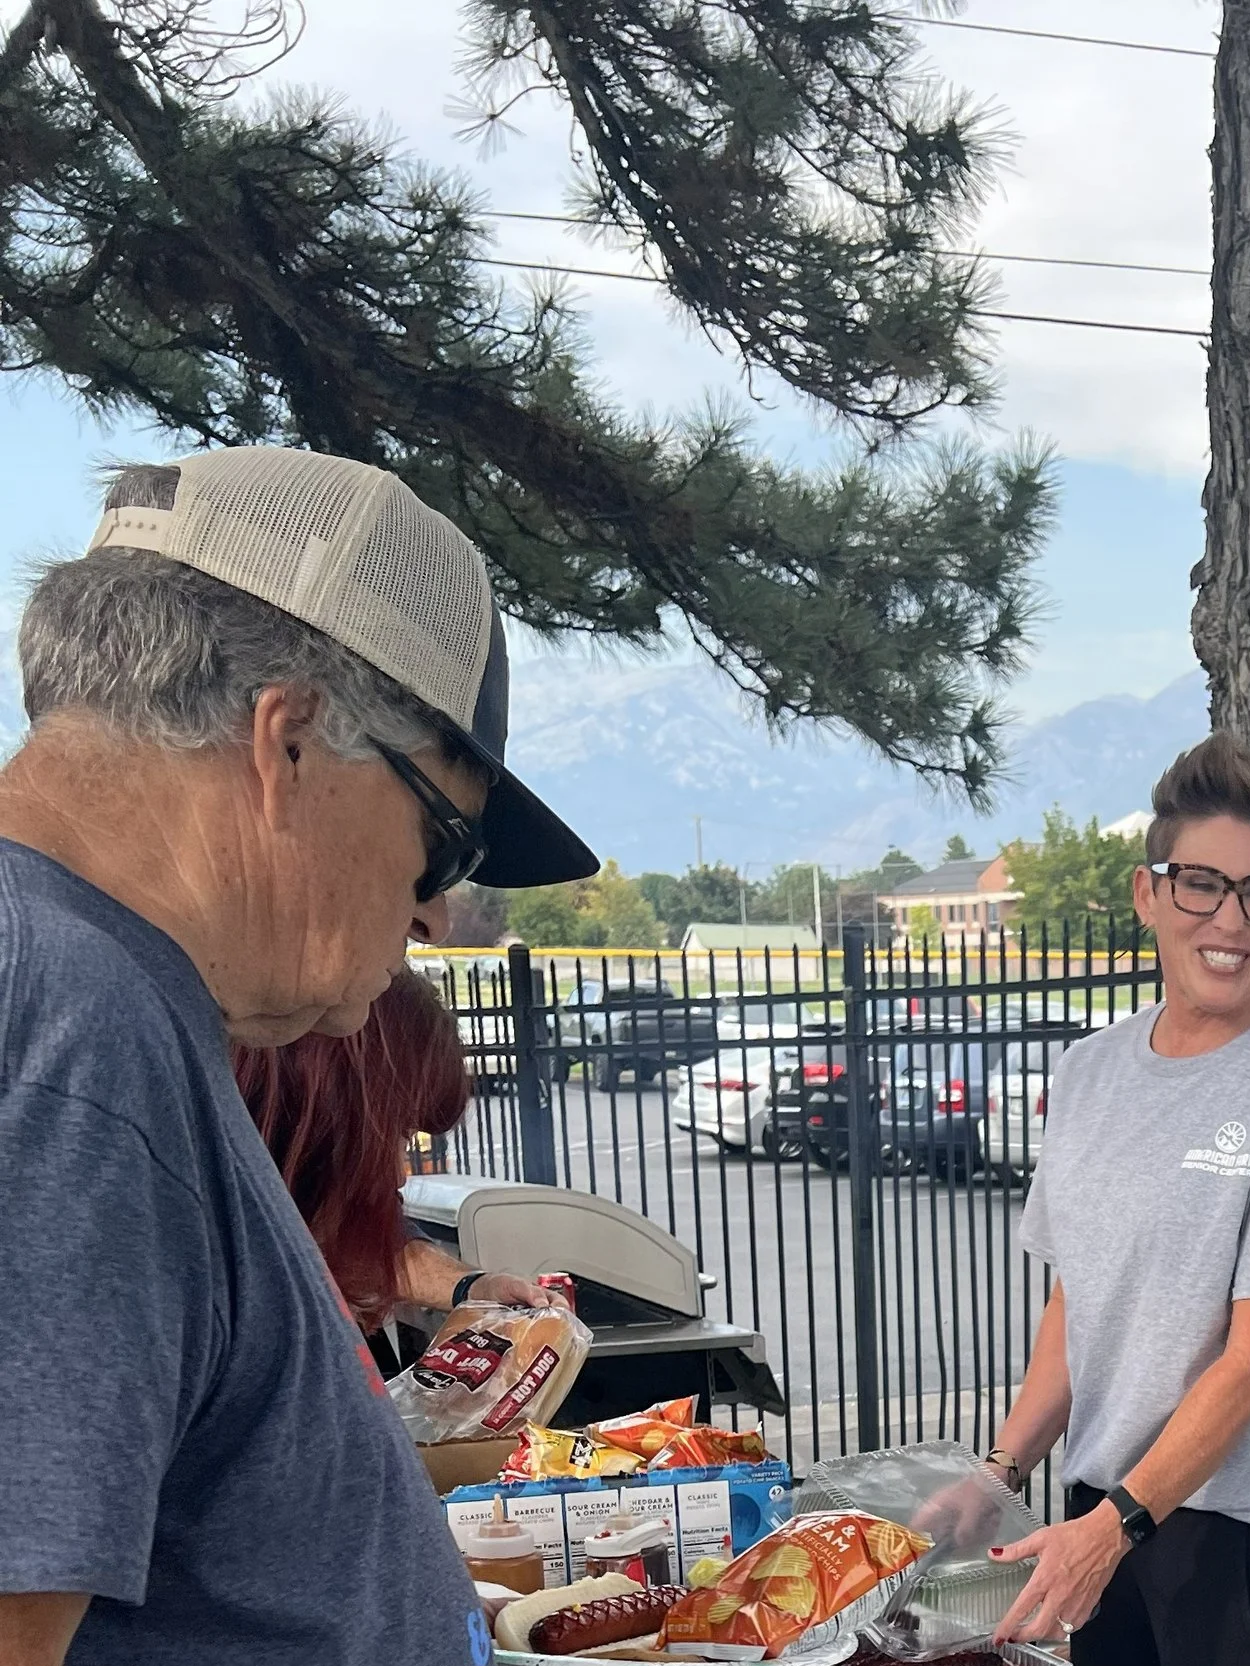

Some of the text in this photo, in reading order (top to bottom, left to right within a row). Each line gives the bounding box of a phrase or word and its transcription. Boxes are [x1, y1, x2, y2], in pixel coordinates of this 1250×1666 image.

[510, 1377, 536, 1404] HOT
[532, 1352, 556, 1380] DOG
[568, 1502, 617, 1512] SOUR CREAM
[630, 1498, 662, 1506] HEDDAR
[460, 1512, 492, 1520] CLASSIC
[514, 1507, 554, 1516] BARBECUE
[841, 1524, 856, 1537] &
[810, 1522, 850, 1553] EAM
